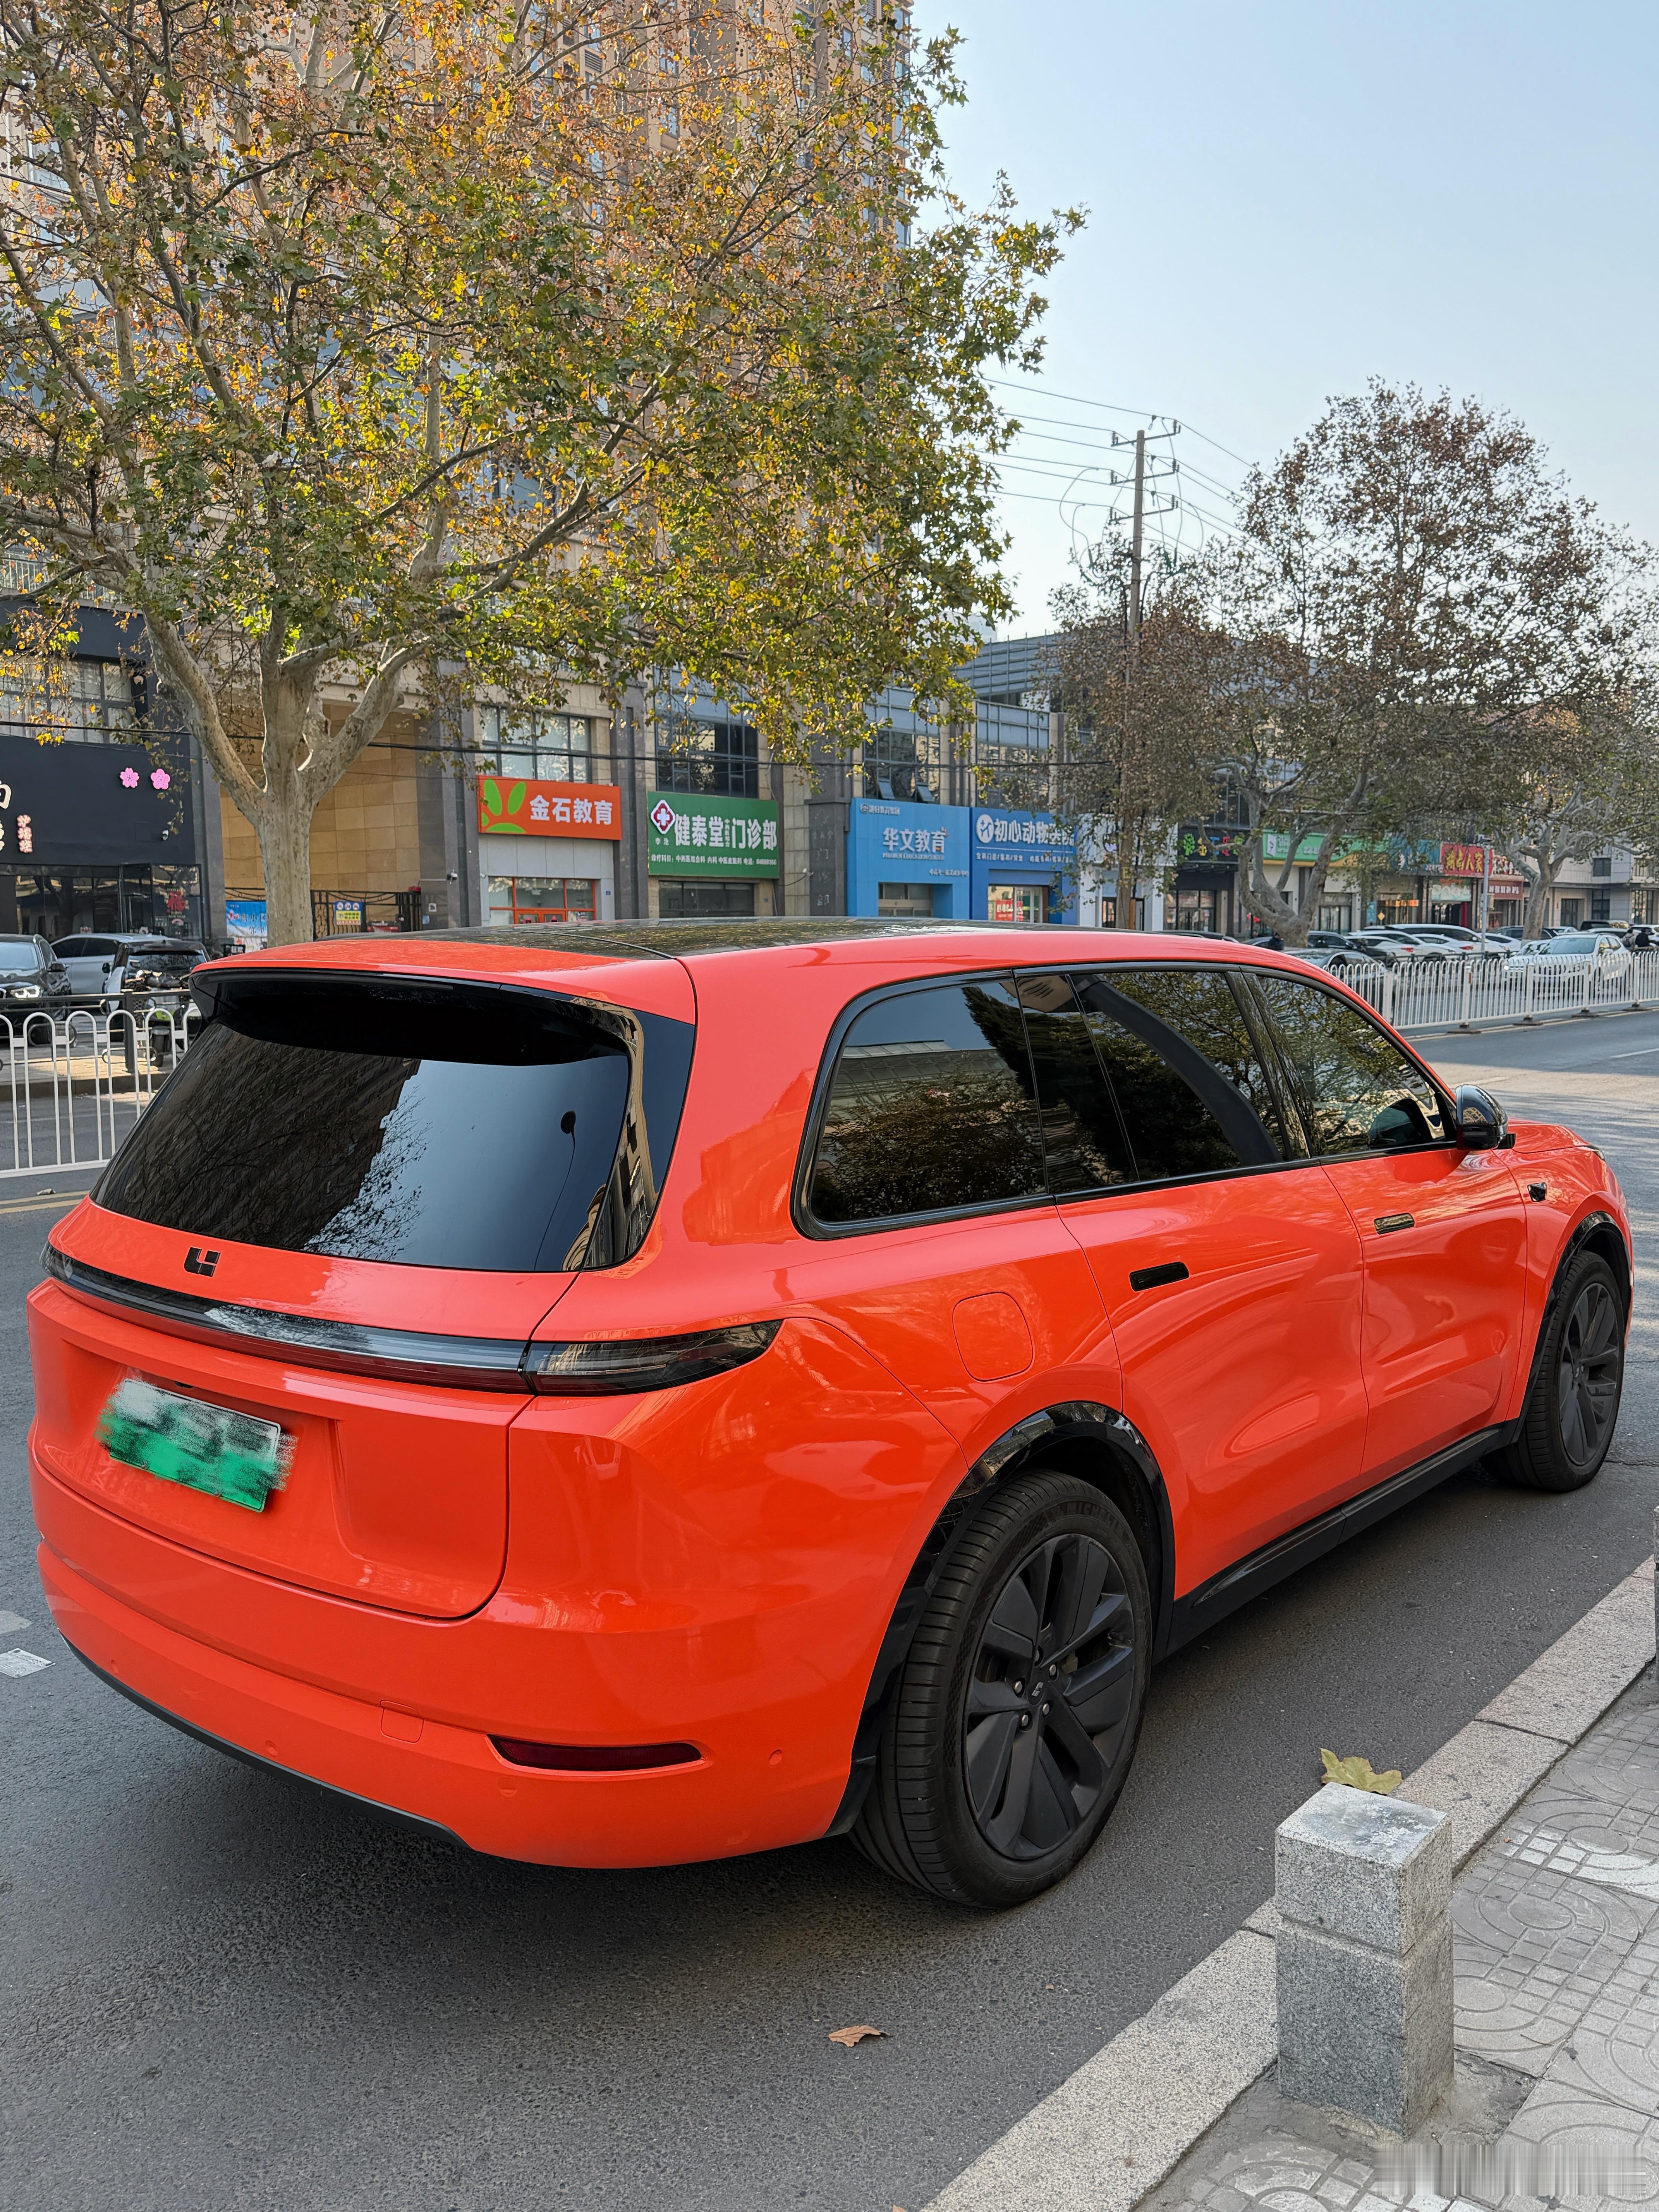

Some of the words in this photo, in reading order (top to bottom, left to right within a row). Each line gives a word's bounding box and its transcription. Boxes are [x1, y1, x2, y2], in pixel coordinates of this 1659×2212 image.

[530, 795, 613, 825] 金石教育
[674, 814, 724, 847] 健泰堂
[732, 817, 777, 851] 门诊部
[883, 827, 946, 854] 华文教育
